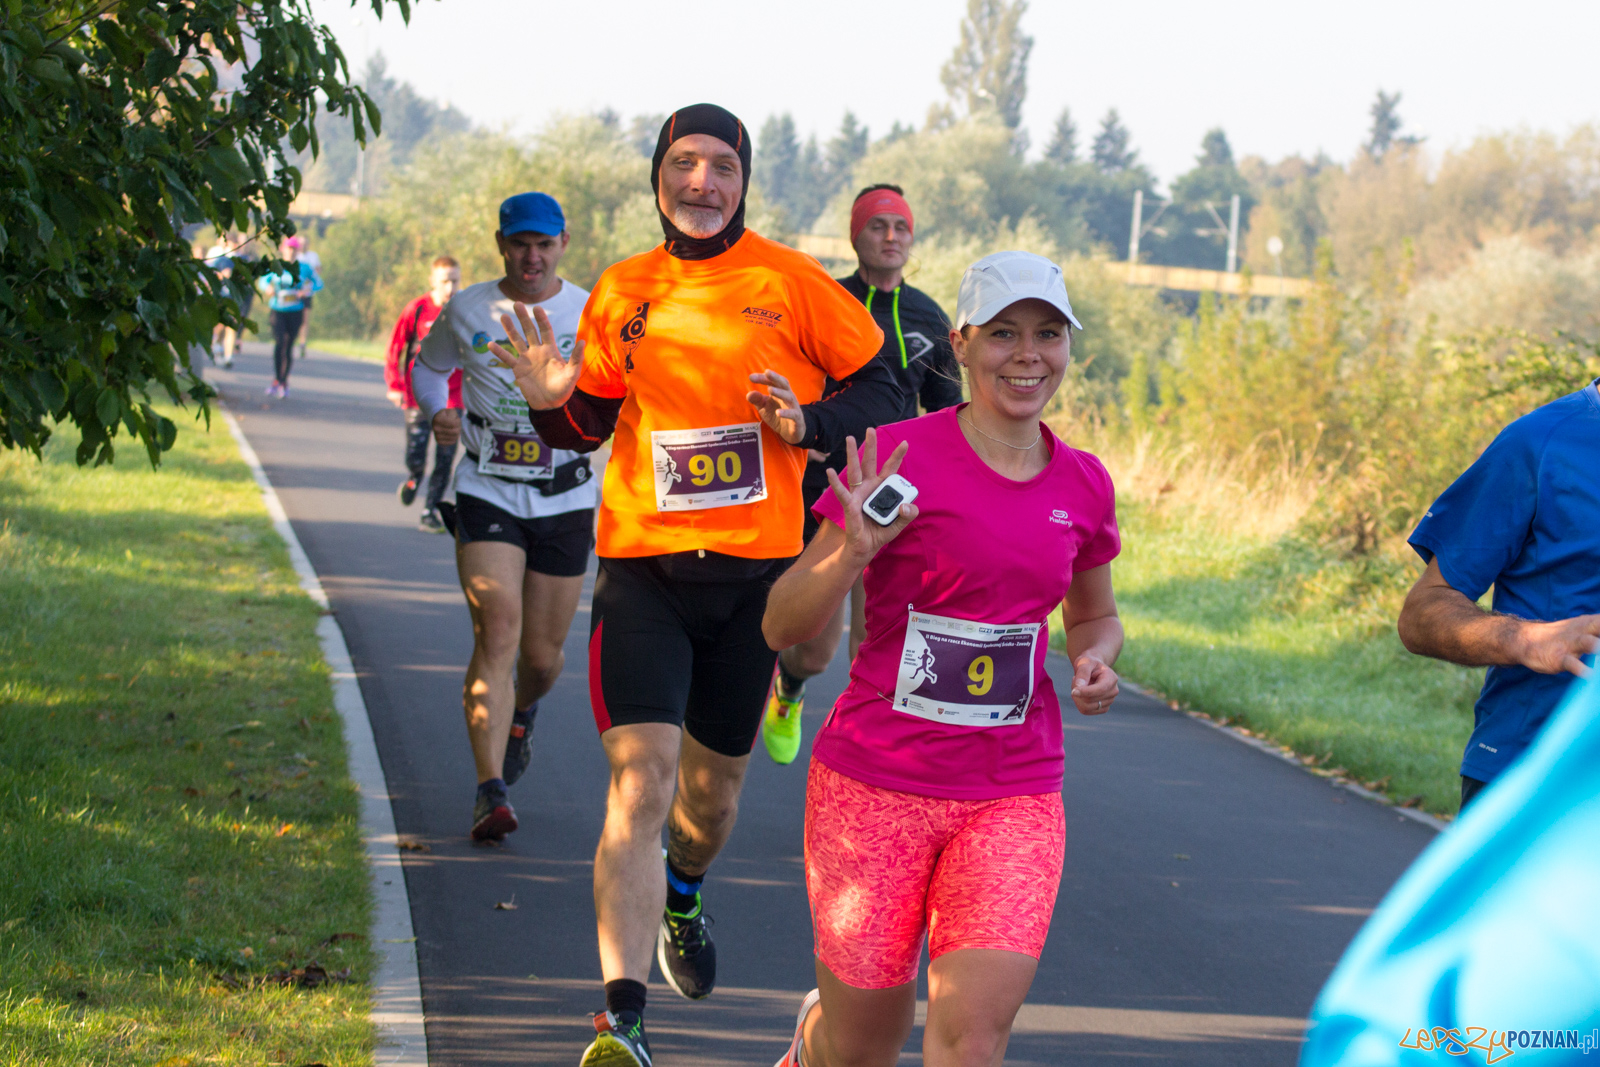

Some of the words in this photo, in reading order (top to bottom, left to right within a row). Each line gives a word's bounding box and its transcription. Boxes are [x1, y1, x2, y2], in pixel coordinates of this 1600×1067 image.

[741, 307, 783, 322] AKMUZ
[504, 439, 541, 463] 99
[688, 451, 742, 487] 90
[930, 634, 941, 642] Bieg
[961, 640, 983, 648] Ekonomii
[966, 655, 994, 696] 9
